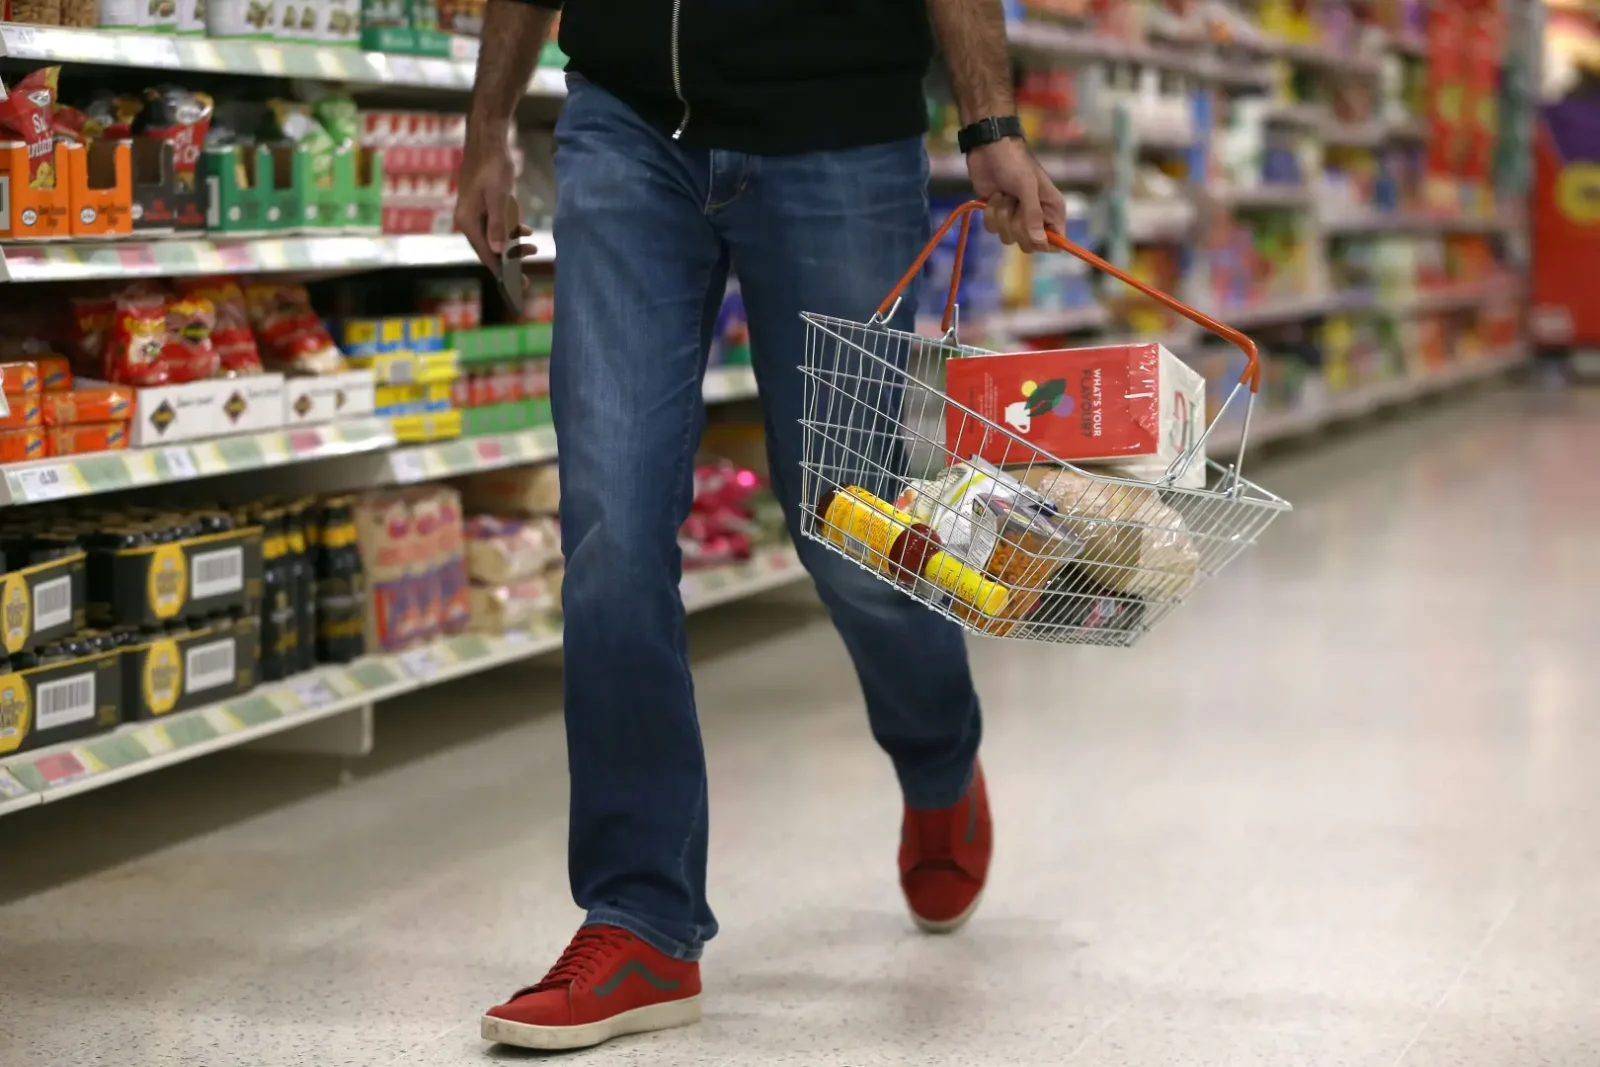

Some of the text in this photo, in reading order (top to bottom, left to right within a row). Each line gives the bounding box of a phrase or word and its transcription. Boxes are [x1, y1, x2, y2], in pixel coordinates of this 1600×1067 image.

[1081, 369, 1092, 438] FLAVOUR?
[1093, 368, 1102, 437] WHAT'S YOUR
